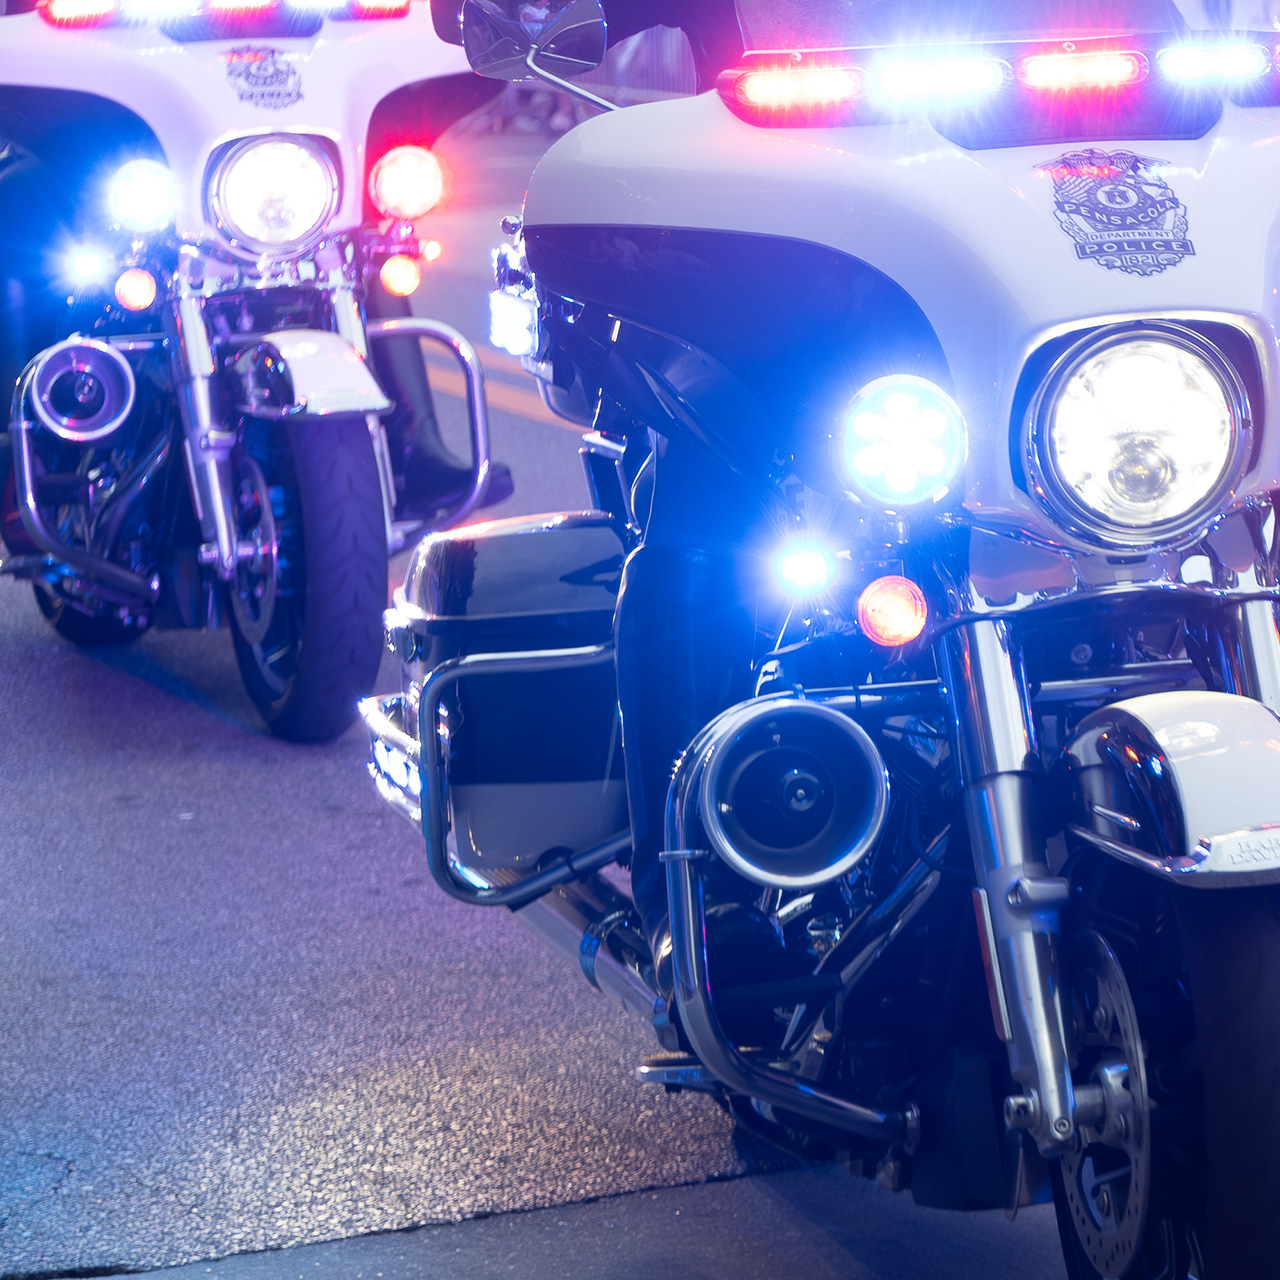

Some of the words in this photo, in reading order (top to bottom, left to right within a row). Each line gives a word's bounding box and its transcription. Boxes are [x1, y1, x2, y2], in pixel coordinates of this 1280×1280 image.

[1063, 199, 1176, 226] PENSACOLA
[1091, 230, 1173, 241] DEPARTMENT
[1085, 241, 1186, 254] POLICE
